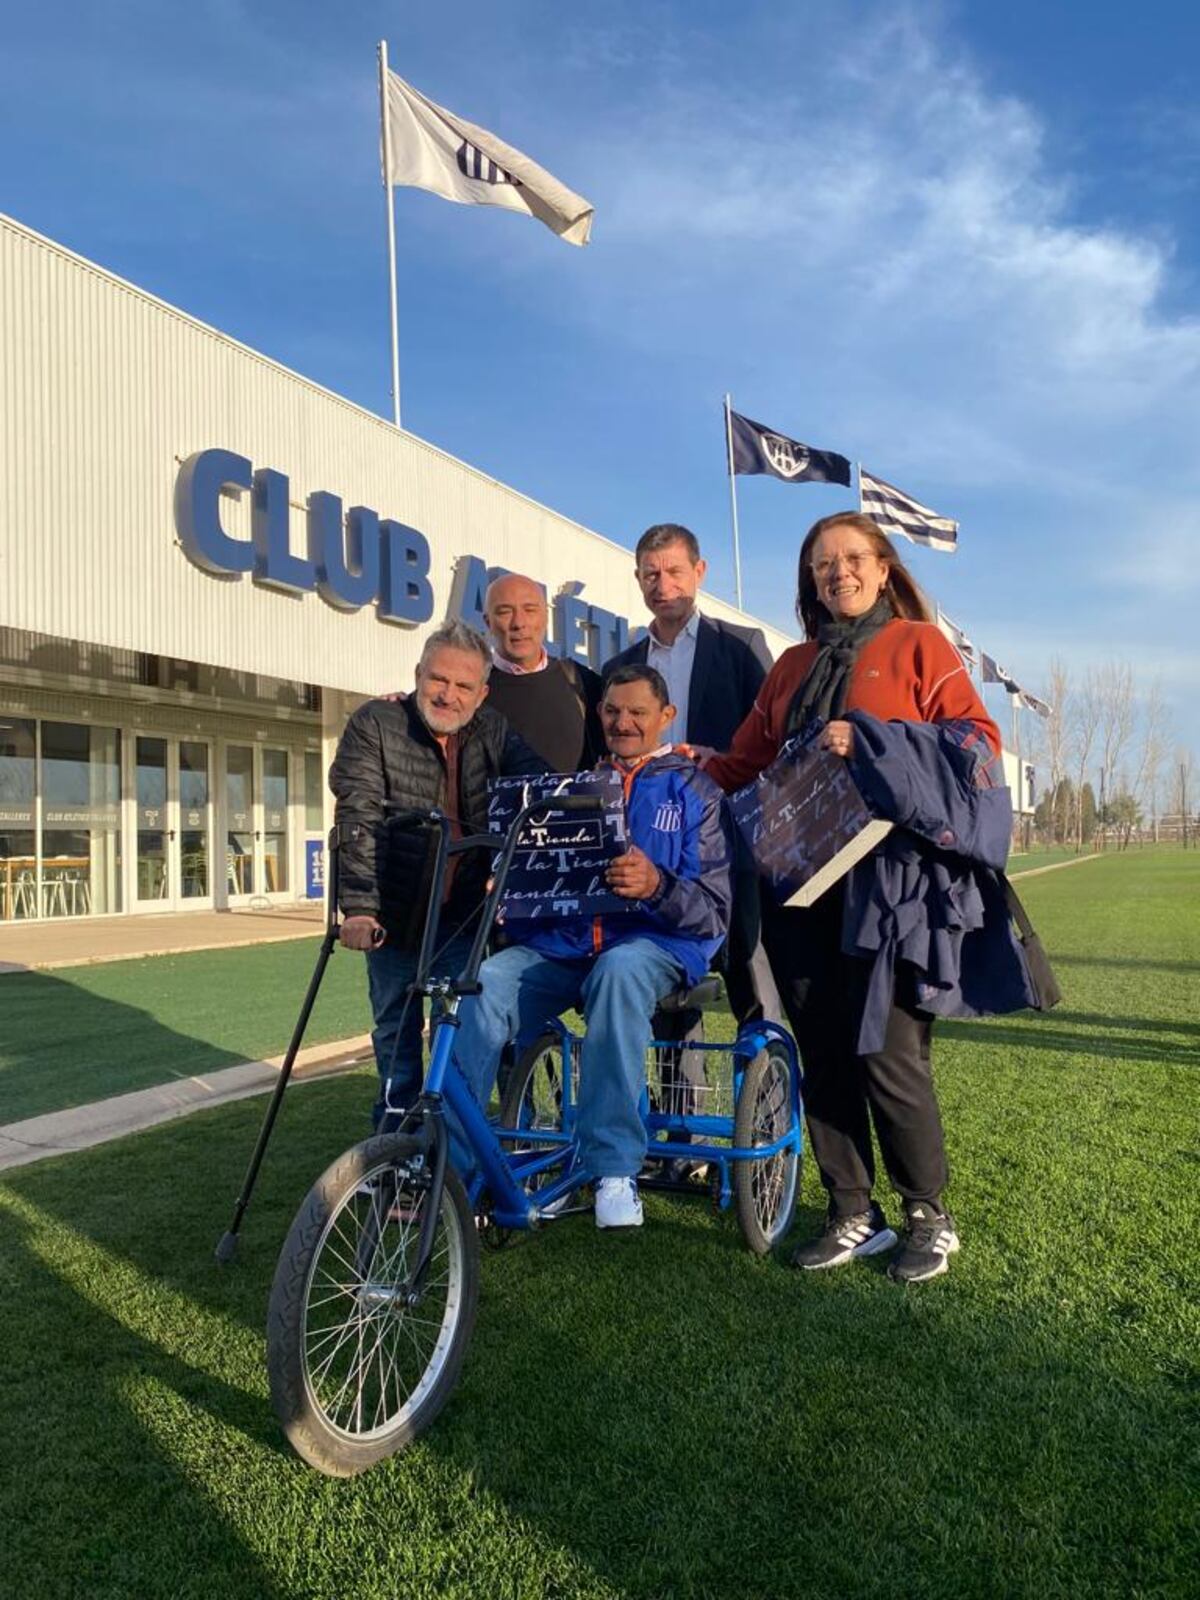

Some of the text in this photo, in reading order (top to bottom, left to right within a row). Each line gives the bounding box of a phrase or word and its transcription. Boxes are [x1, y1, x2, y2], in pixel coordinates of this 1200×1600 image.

[174, 448, 435, 627] CLUB
[530, 827, 596, 846] Tienda
[503, 877, 580, 899] ienda
